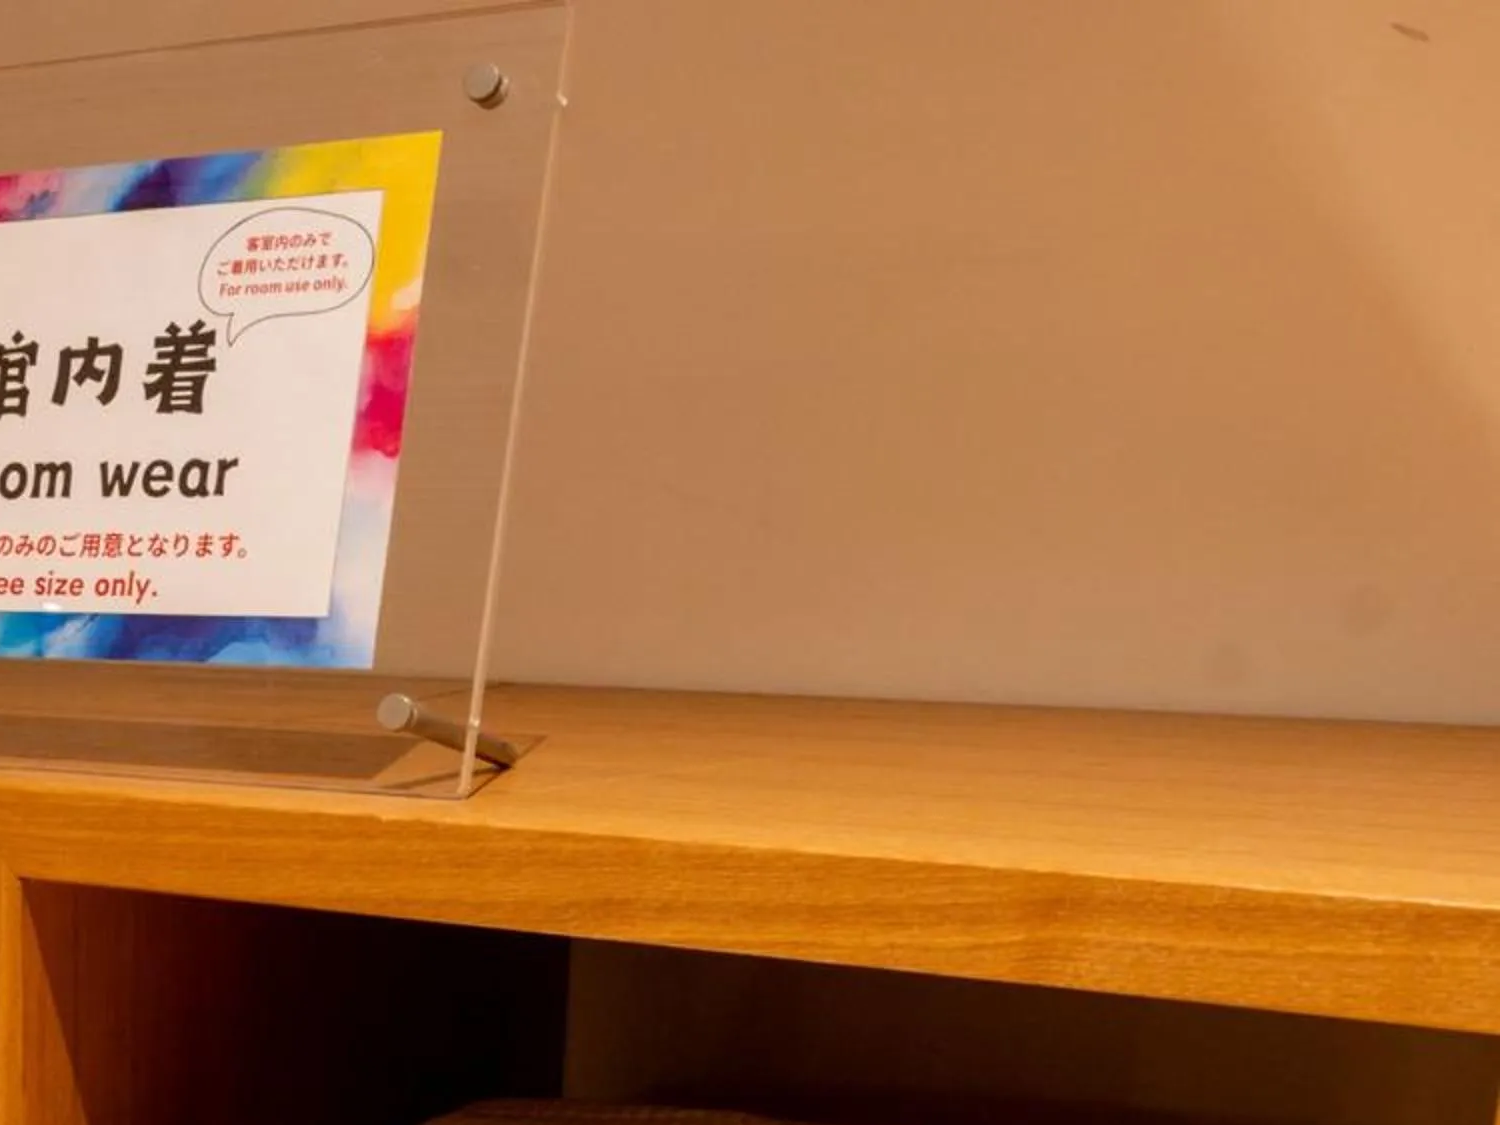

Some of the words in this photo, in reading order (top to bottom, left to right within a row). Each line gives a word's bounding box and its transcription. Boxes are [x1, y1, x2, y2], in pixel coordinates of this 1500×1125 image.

[247, 232, 331, 251] 客室内のみで
[219, 282, 242, 297] For
[244, 281, 283, 295] room
[285, 280, 310, 293] use
[313, 275, 348, 294] only.
[99, 457, 239, 498] wear
[35, 571, 84, 596] size
[95, 571, 158, 604] only.
